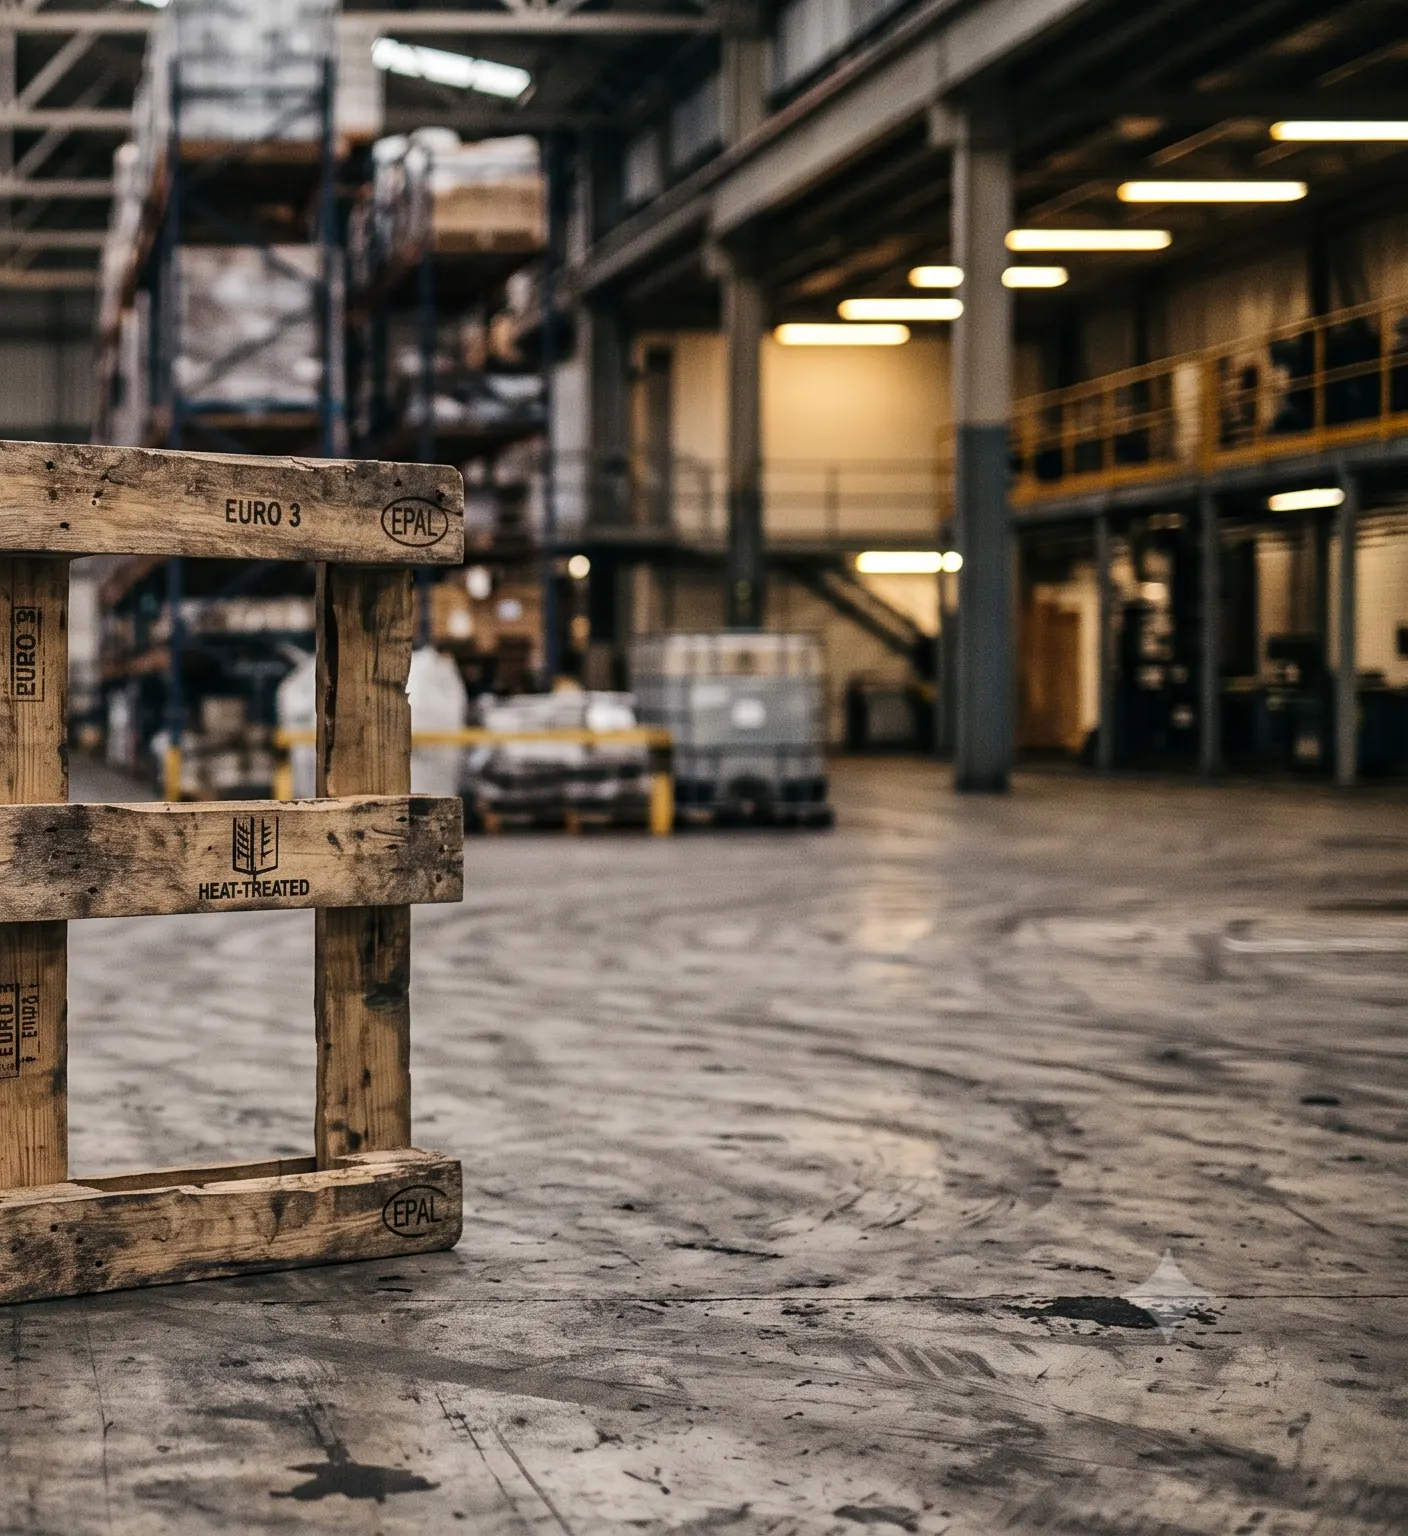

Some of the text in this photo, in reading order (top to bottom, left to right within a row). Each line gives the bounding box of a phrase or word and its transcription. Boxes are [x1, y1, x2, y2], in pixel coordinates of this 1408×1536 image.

[225, 499, 301, 527] EURO 3
[391, 507, 438, 537] EPAL
[198, 879, 310, 900] HEAT-TREATED
[393, 1196, 443, 1228] EPAL
